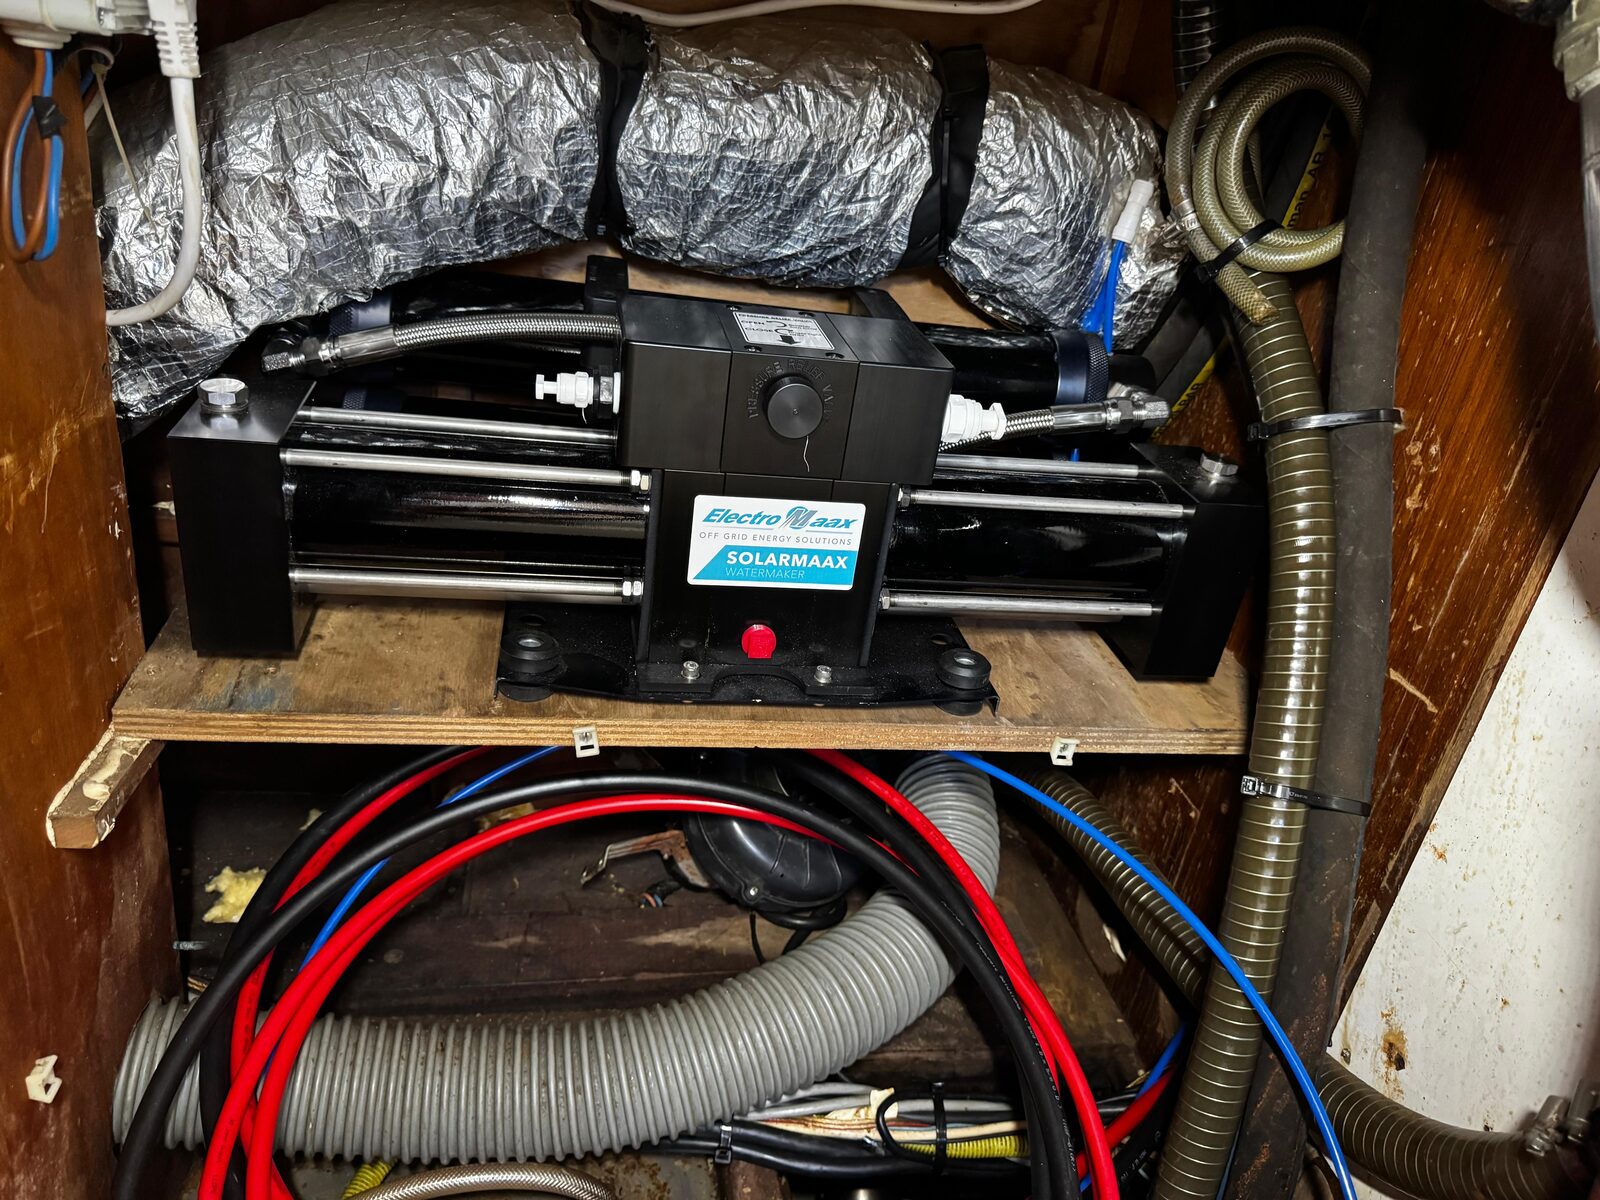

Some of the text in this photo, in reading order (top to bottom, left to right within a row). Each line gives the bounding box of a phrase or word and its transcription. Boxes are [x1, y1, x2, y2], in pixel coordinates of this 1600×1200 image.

[699, 531, 853, 546] OFF GRID ENERGY SOLUTIONS
[726, 550, 849, 570] SOLARMAAX
[725, 567, 806, 580] WATERMAKER
